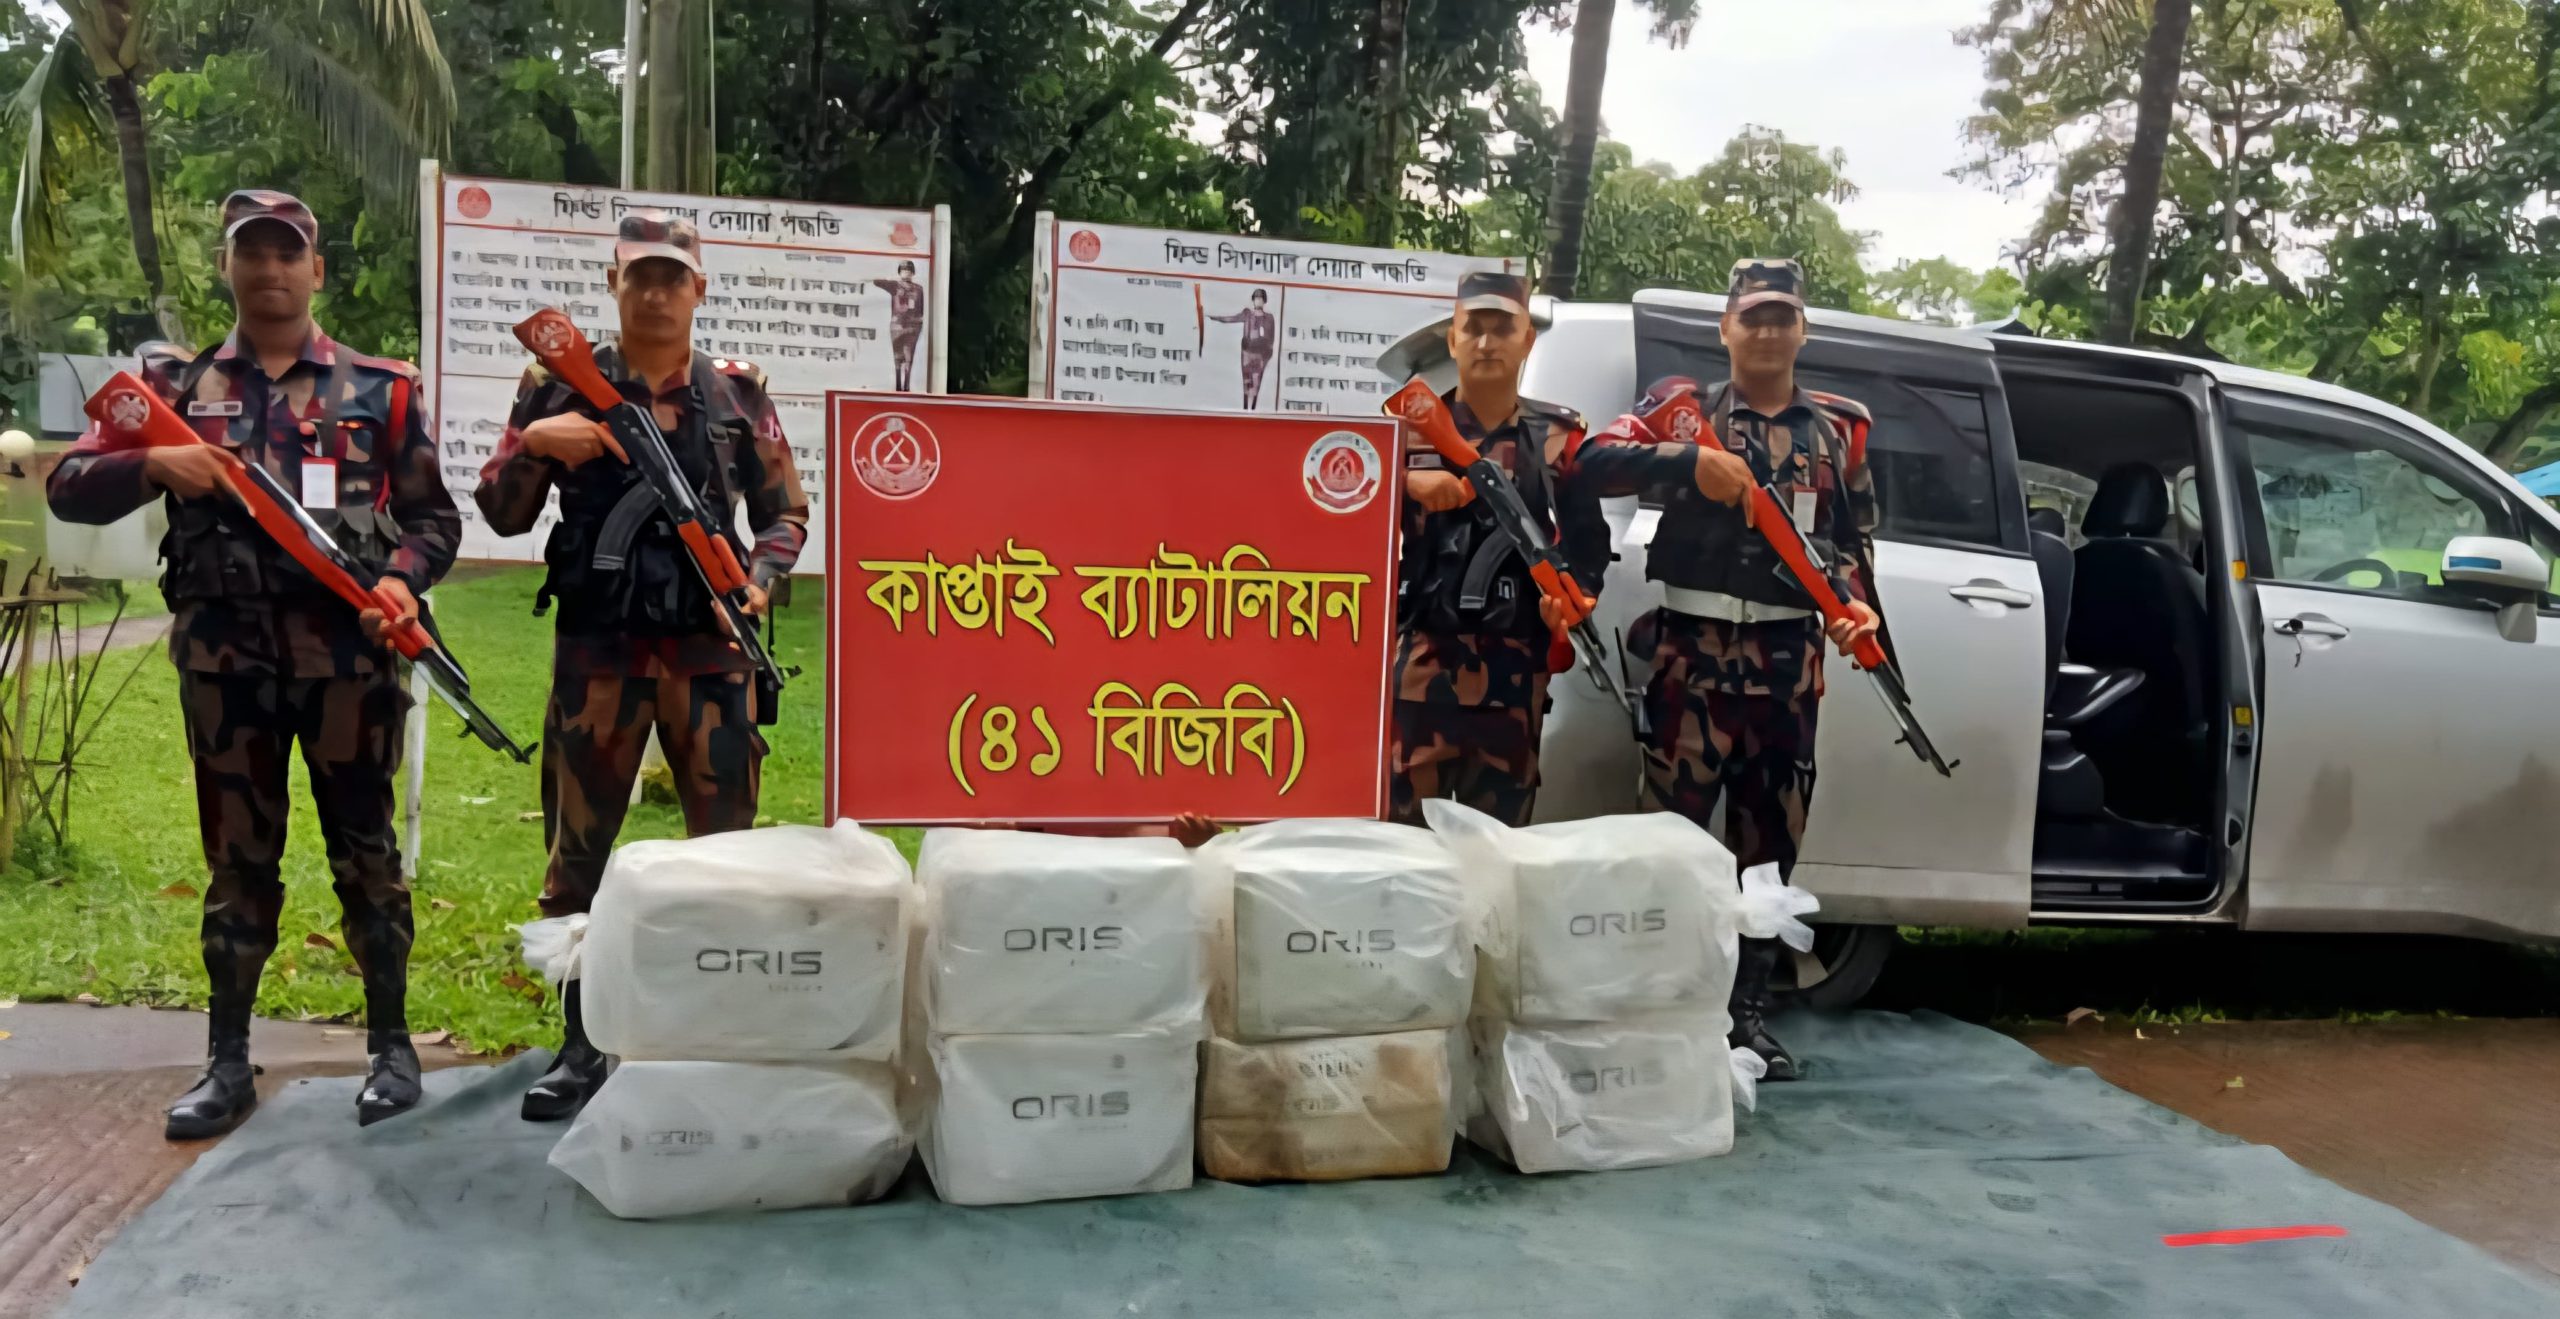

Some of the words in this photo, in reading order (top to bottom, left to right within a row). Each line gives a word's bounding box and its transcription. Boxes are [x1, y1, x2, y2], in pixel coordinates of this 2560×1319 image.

[858, 537, 1060, 647] কাপ্তাই
[1073, 542, 1371, 644] ব্যাটালিয়ন
[948, 693, 1061, 797] (৪১
[1088, 682, 1306, 797] বিজিবি)
[1570, 908, 1666, 936] ORIS
[1004, 926, 1123, 952] ORIS
[1287, 930, 1396, 953] ORIS
[696, 949, 822, 975] ORIS
[1012, 1091, 1130, 1119] ORIS
